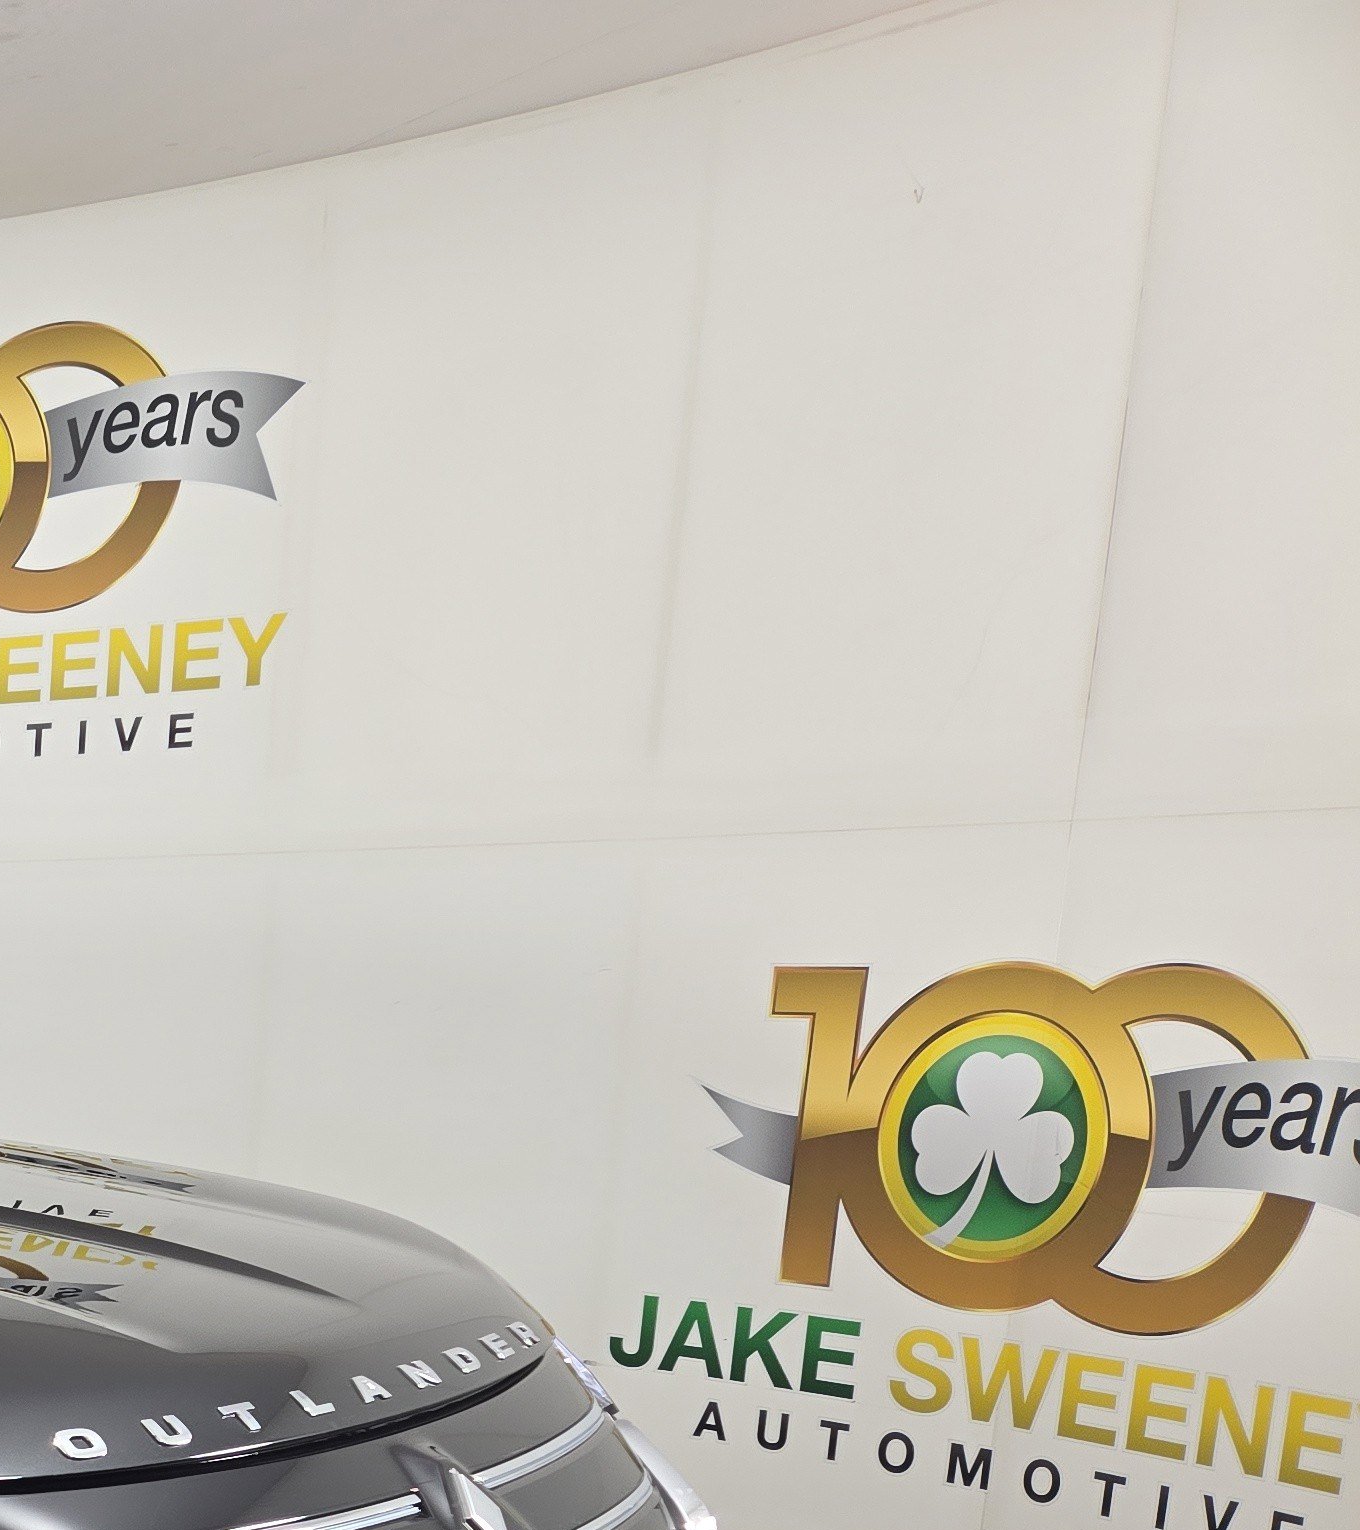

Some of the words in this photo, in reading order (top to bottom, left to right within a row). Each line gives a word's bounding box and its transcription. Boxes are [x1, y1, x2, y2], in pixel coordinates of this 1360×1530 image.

[62, 387, 245, 483] years
[52, 1319, 541, 1461] OUTLANDER
[609, 1294, 862, 1400] JAKE
[889, 1328, 1360, 1495] SWEENE
